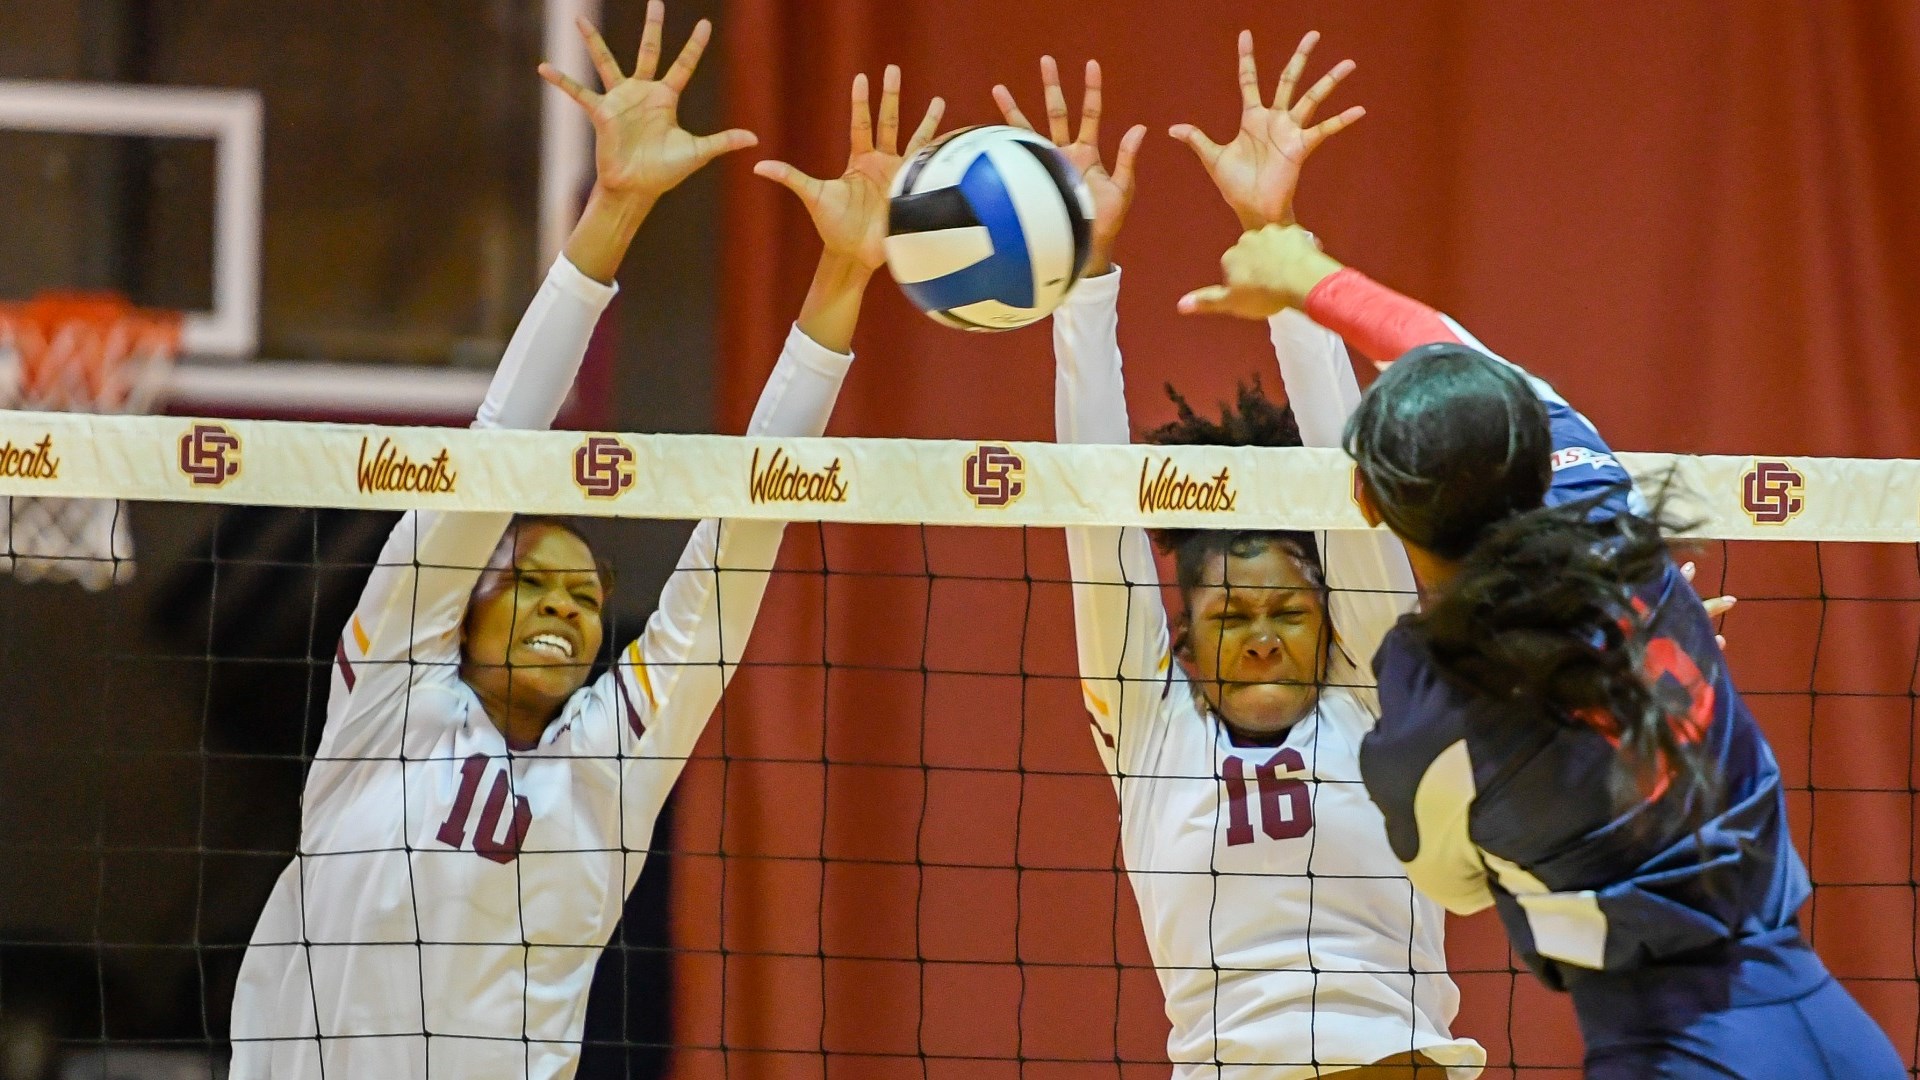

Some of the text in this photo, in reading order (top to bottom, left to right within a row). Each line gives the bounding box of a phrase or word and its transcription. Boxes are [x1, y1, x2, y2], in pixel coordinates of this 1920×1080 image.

[358, 436, 456, 493] Wildcats
[750, 447, 848, 504] Wildcats
[1139, 457, 1237, 513] Wildcats
[436, 752, 533, 864] 10
[1222, 747, 1313, 847] 16
